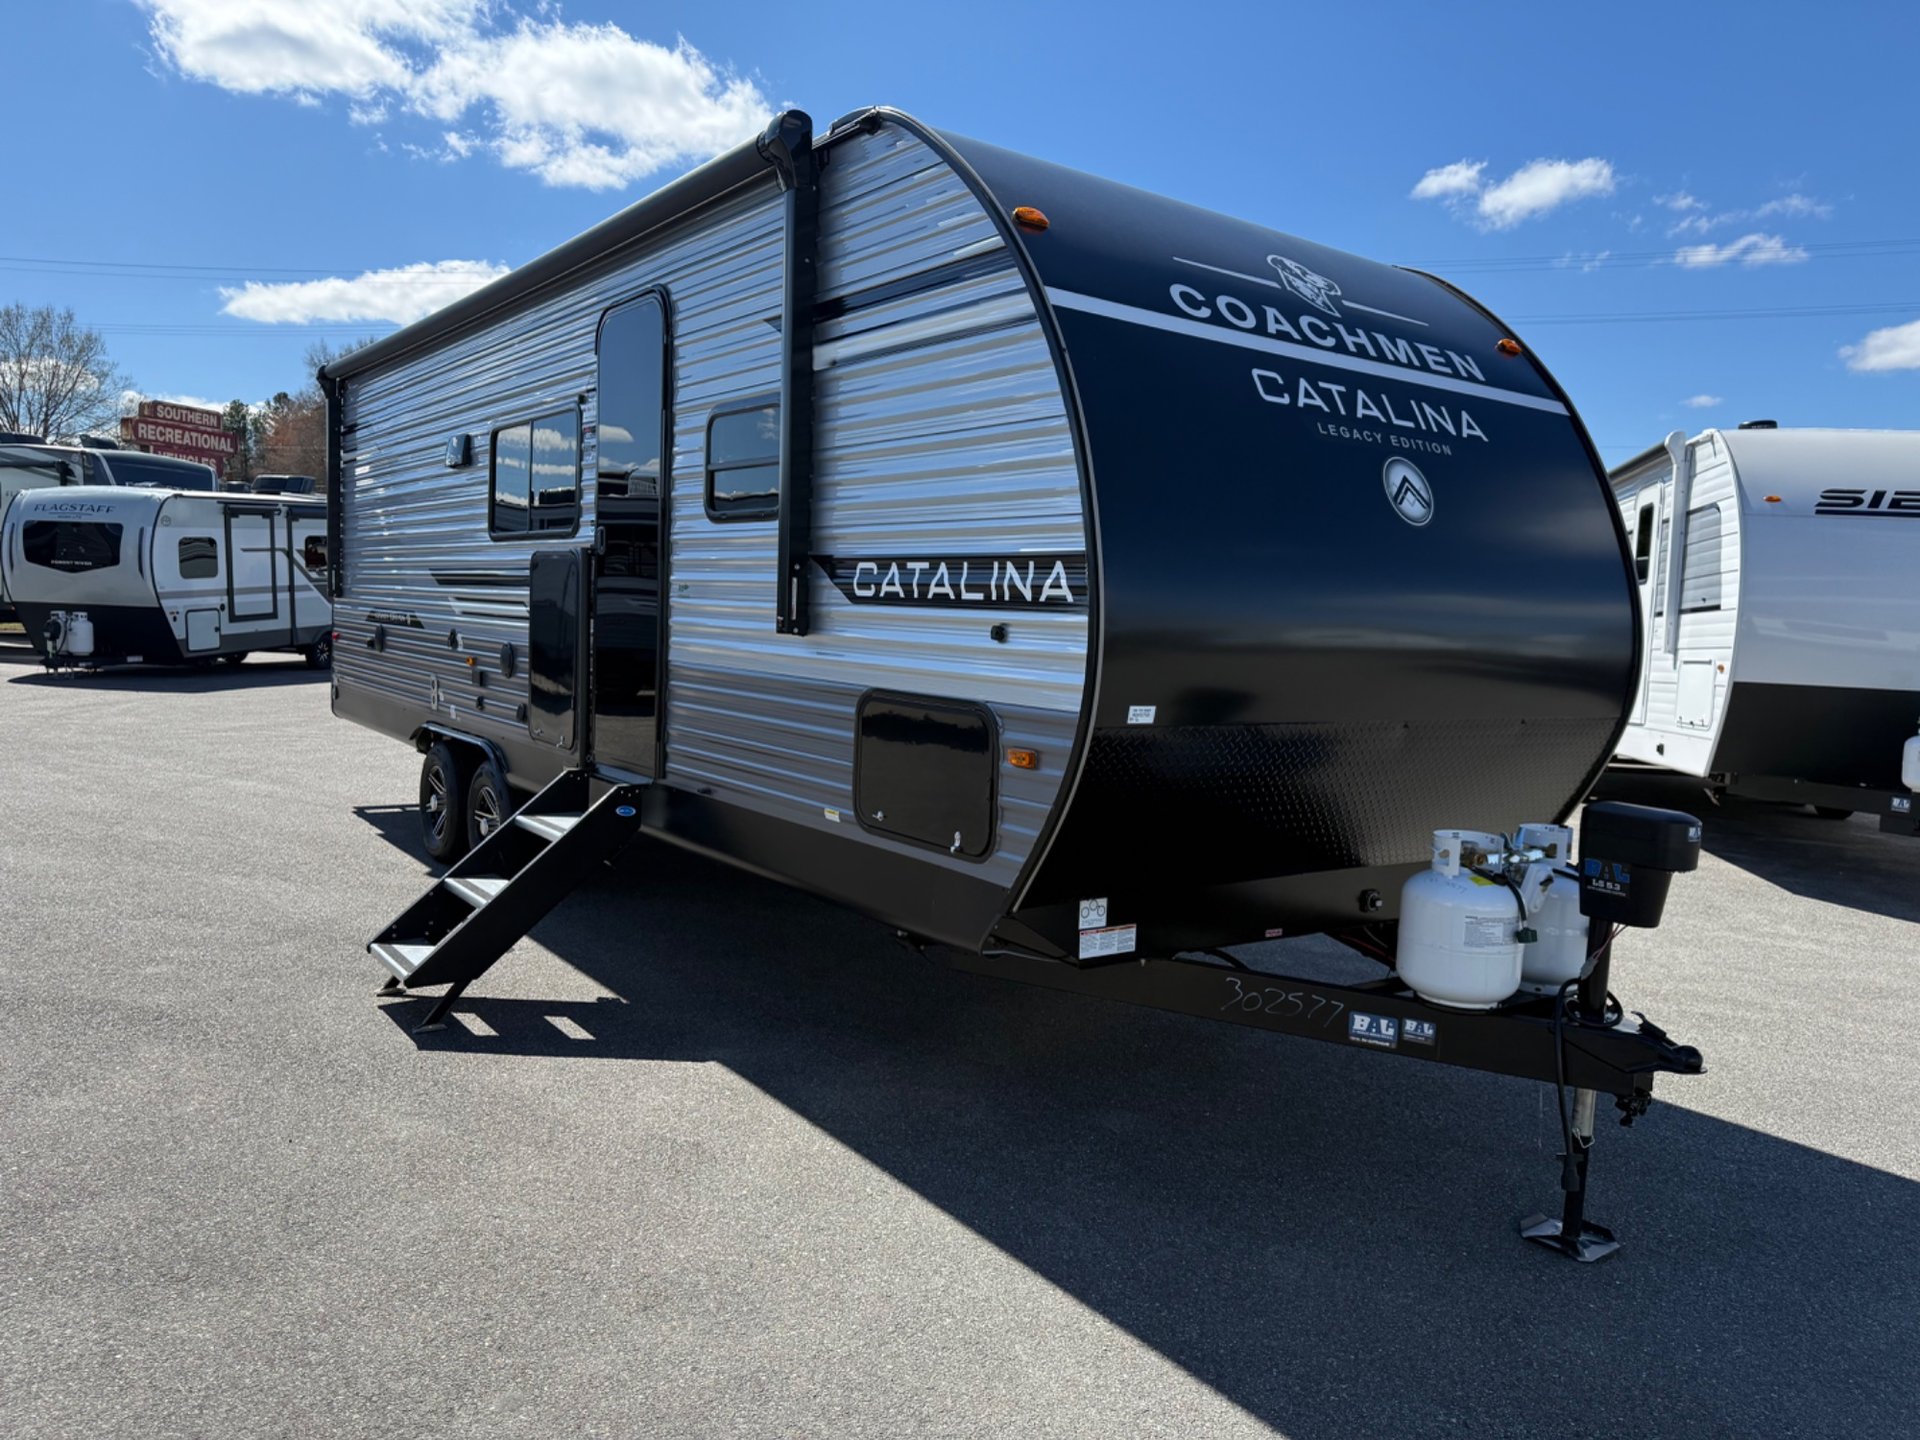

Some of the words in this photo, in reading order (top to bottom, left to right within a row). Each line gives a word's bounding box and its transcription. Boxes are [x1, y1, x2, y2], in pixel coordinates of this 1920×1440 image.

[1169, 283, 1486, 382] COACHMEN
[156, 404, 218, 428] SOUTHERN
[1251, 368, 1489, 443] CATALINA
[137, 422, 235, 454] RECREATIONAL
[1317, 422, 1383, 445] LEGACY
[1391, 434, 1453, 456] EDITION
[33, 503, 117, 514] FLAGSTAFF
[853, 560, 1075, 604] CATALINA
[1220, 977, 1345, 1028] 302577
[1352, 1014, 1395, 1036] BAL
